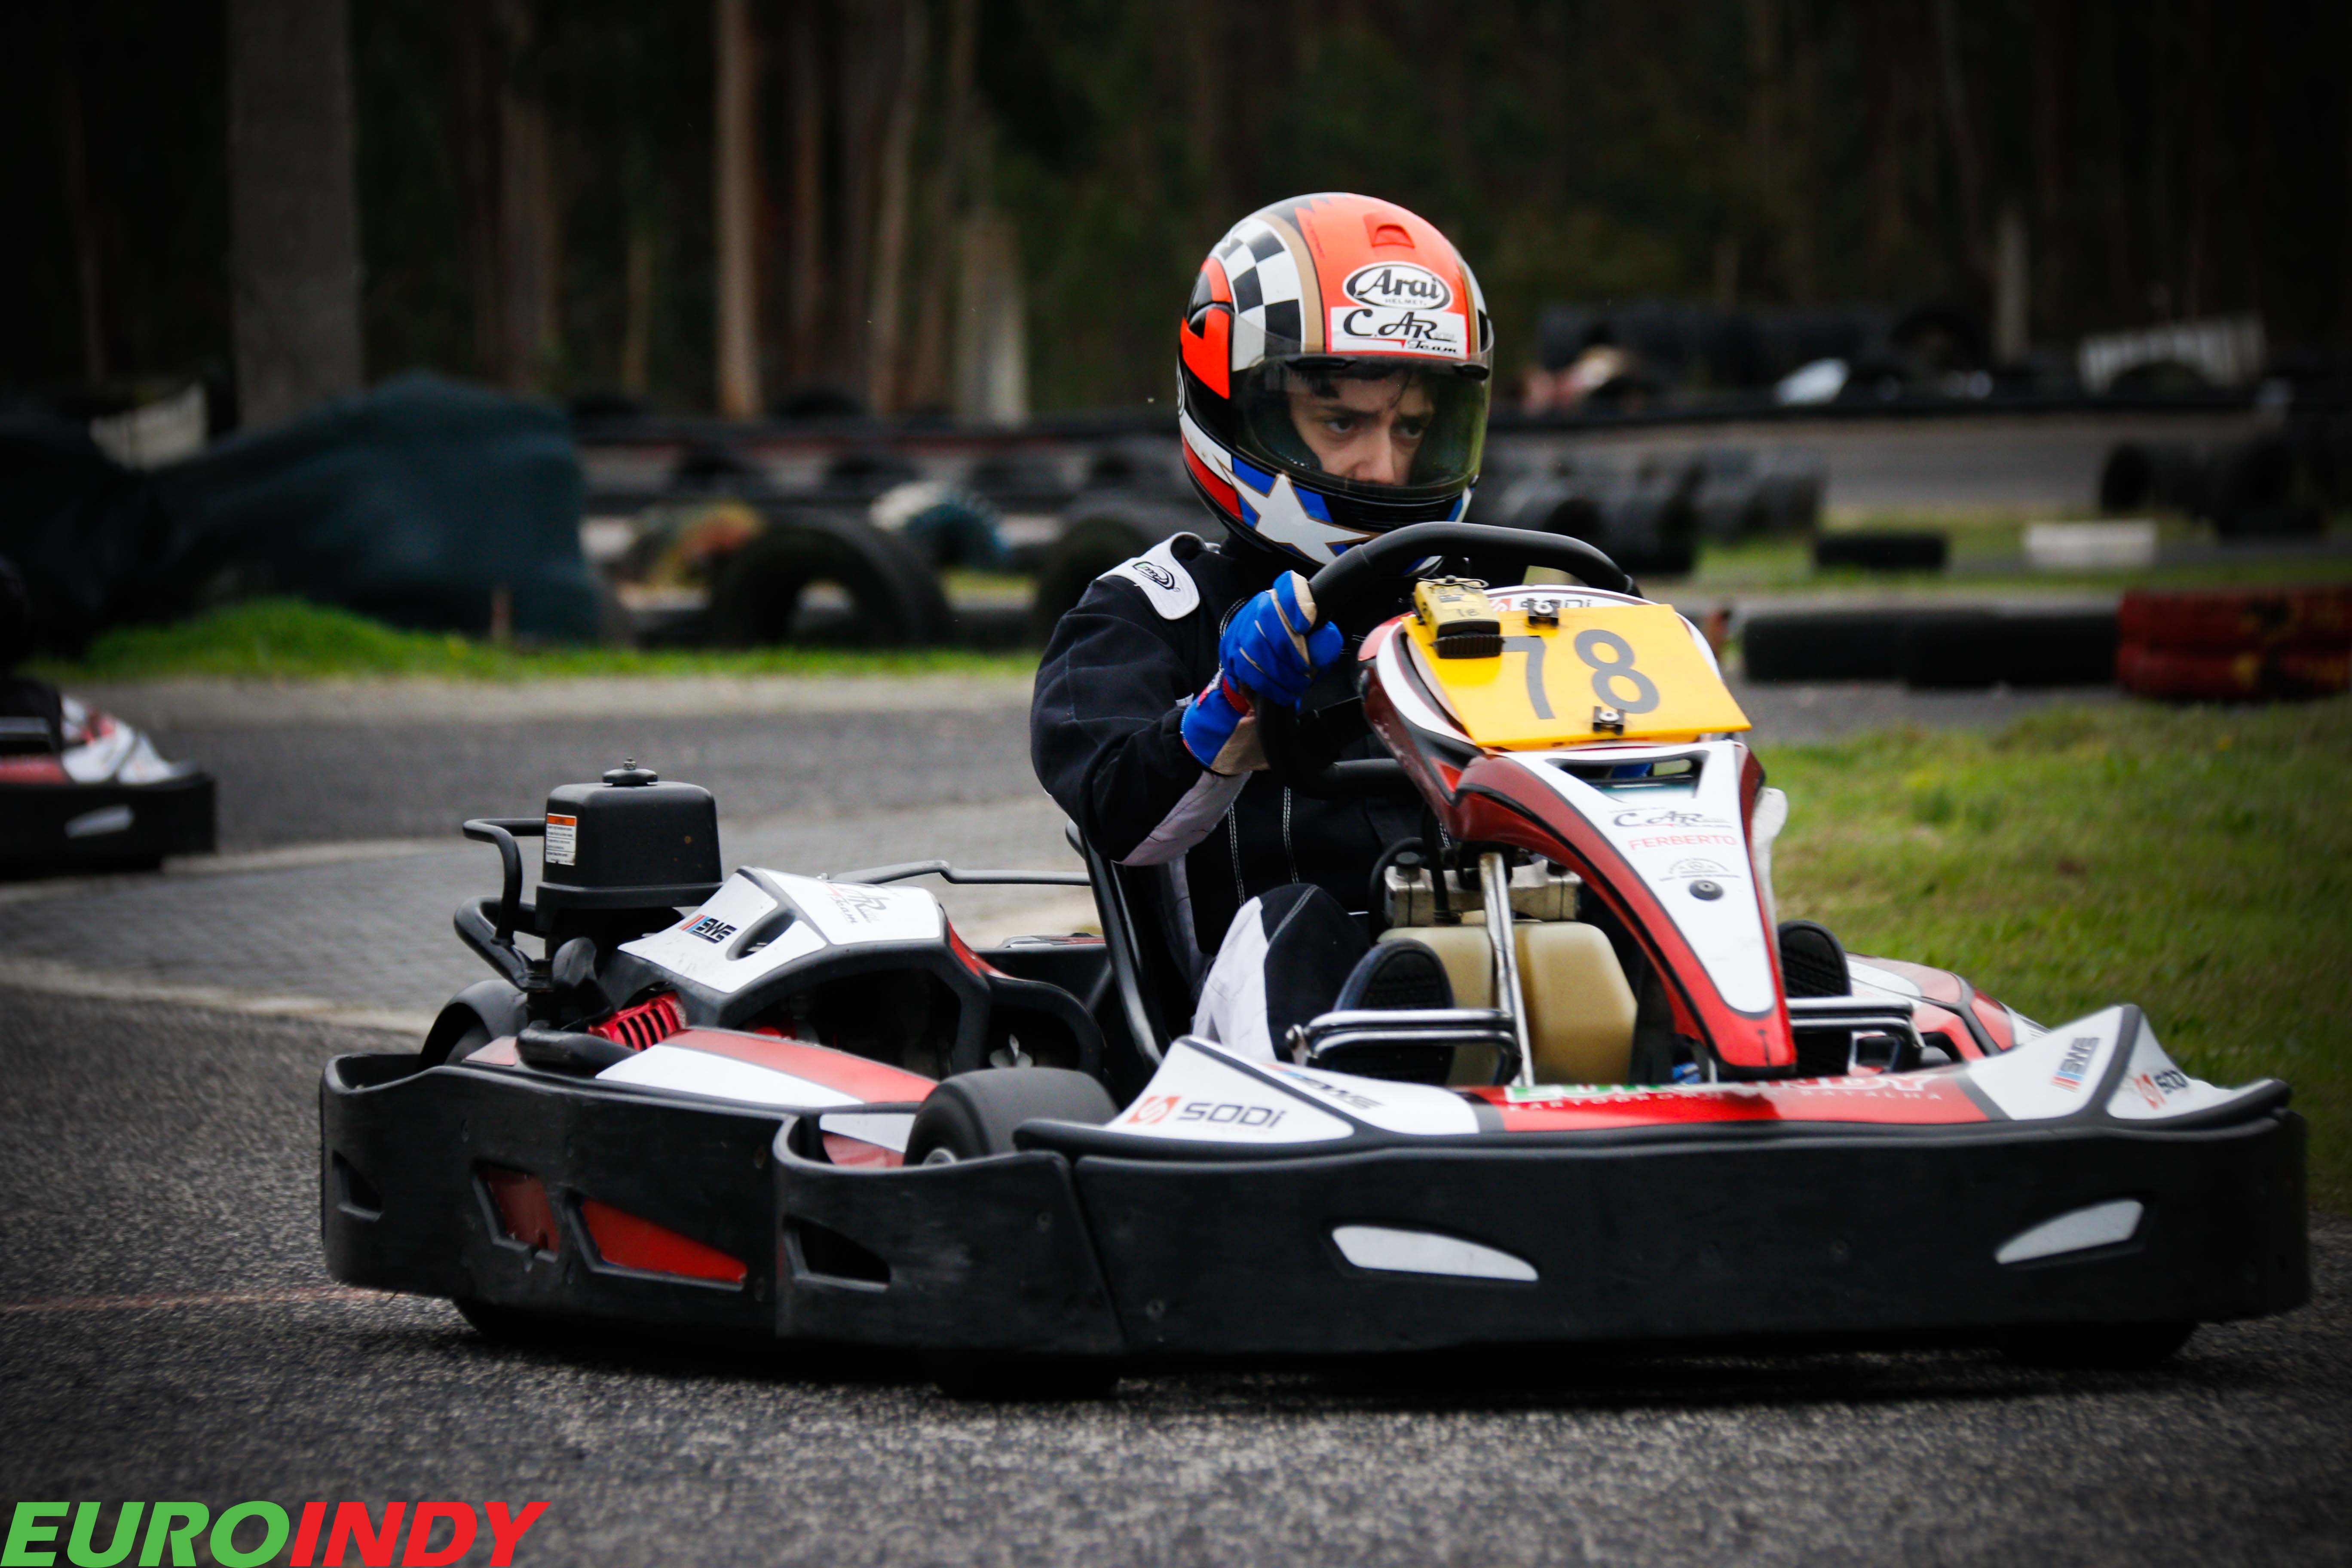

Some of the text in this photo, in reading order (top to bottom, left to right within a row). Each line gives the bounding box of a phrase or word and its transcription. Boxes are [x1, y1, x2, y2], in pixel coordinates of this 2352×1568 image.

[1356, 268, 1439, 299] Arai
[1407, 339, 1457, 353] Team
[1520, 598, 1592, 608] SDi
[1503, 629, 1660, 720] 78
[1628, 835, 1738, 850] FERBERTO
[1504, 1074, 1940, 1103] EURINDY
